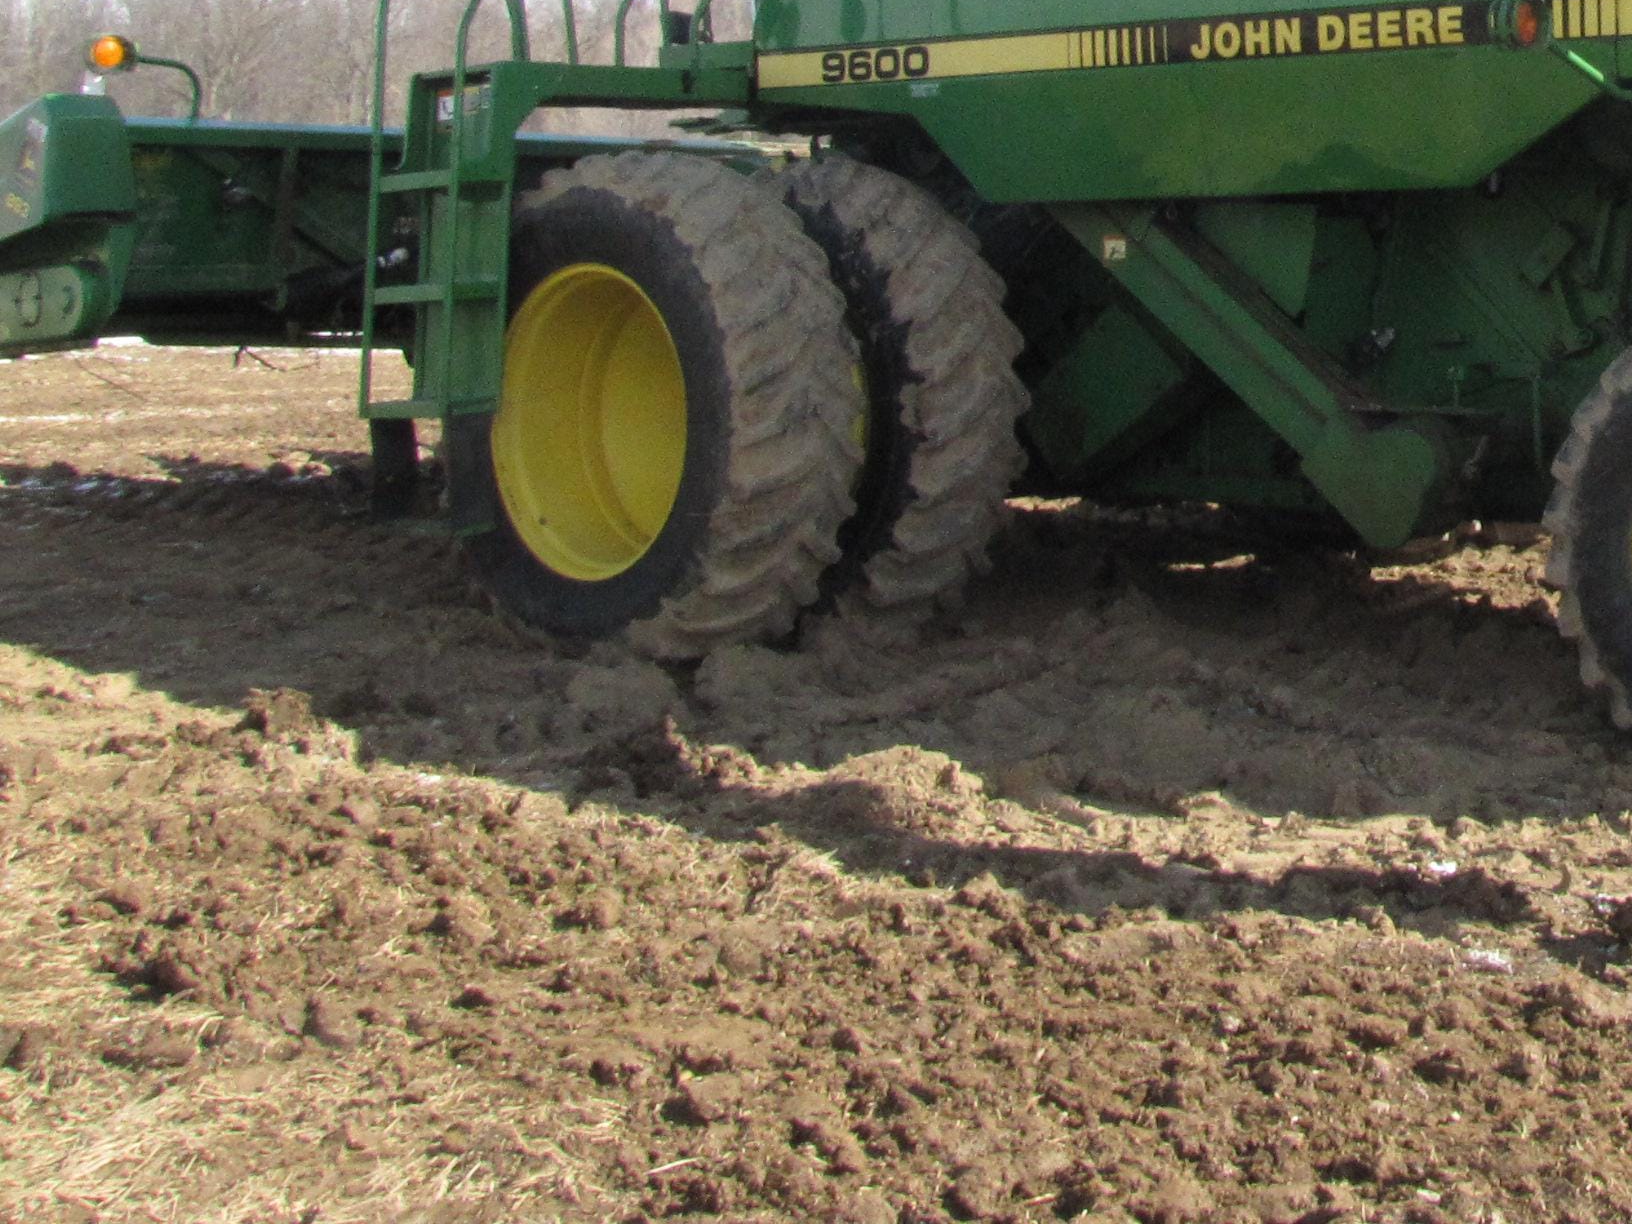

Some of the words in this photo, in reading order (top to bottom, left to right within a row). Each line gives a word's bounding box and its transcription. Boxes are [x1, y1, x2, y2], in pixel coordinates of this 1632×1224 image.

[1190, 16, 1302, 60] JOHN
[1316, 5, 1465, 52] DEERE
[822, 46, 929, 82] 9600
